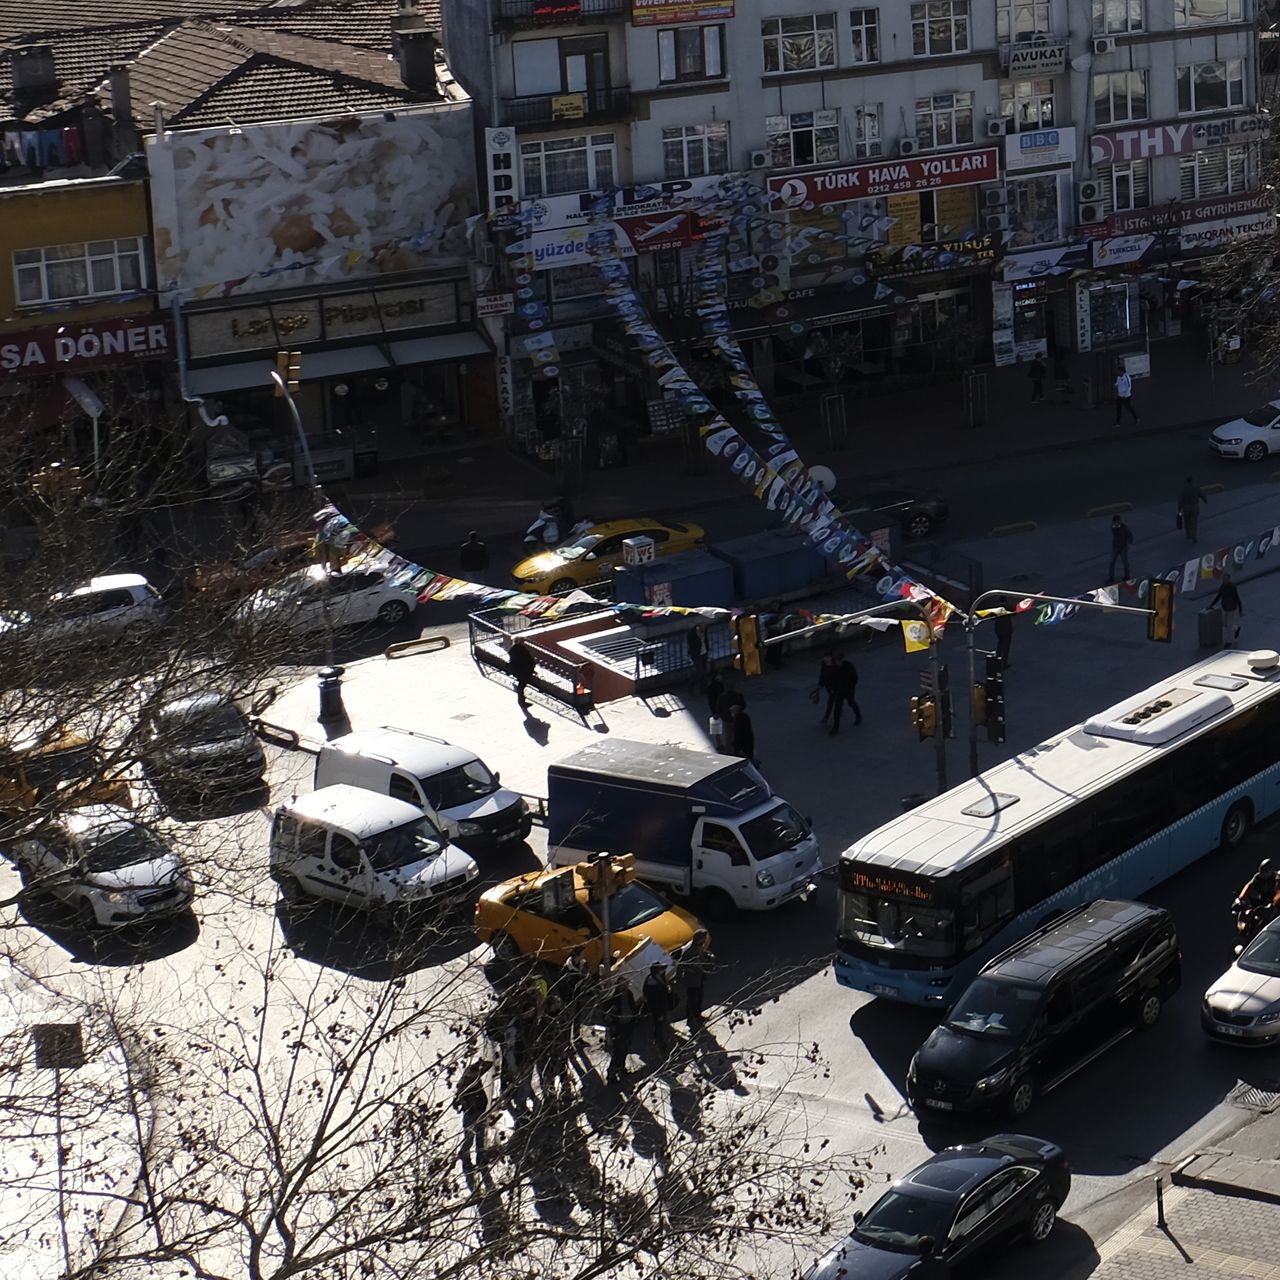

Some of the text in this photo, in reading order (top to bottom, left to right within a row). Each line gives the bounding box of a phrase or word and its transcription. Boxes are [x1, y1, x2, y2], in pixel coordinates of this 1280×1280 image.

[1012, 47, 1064, 63] AVUKAT
[1022, 132, 1057, 148] BBC
[1115, 124, 1191, 160] THY
[814, 154, 988, 191] TÜRK HAVA YOLLARI
[867, 176, 942, 194] 0212 458 26 26
[1108, 245, 1142, 256] TURKCELL
[787, 288, 815, 300] CAFE
[55, 323, 168, 362] DÖNER
[637, 546, 653, 557] WC
